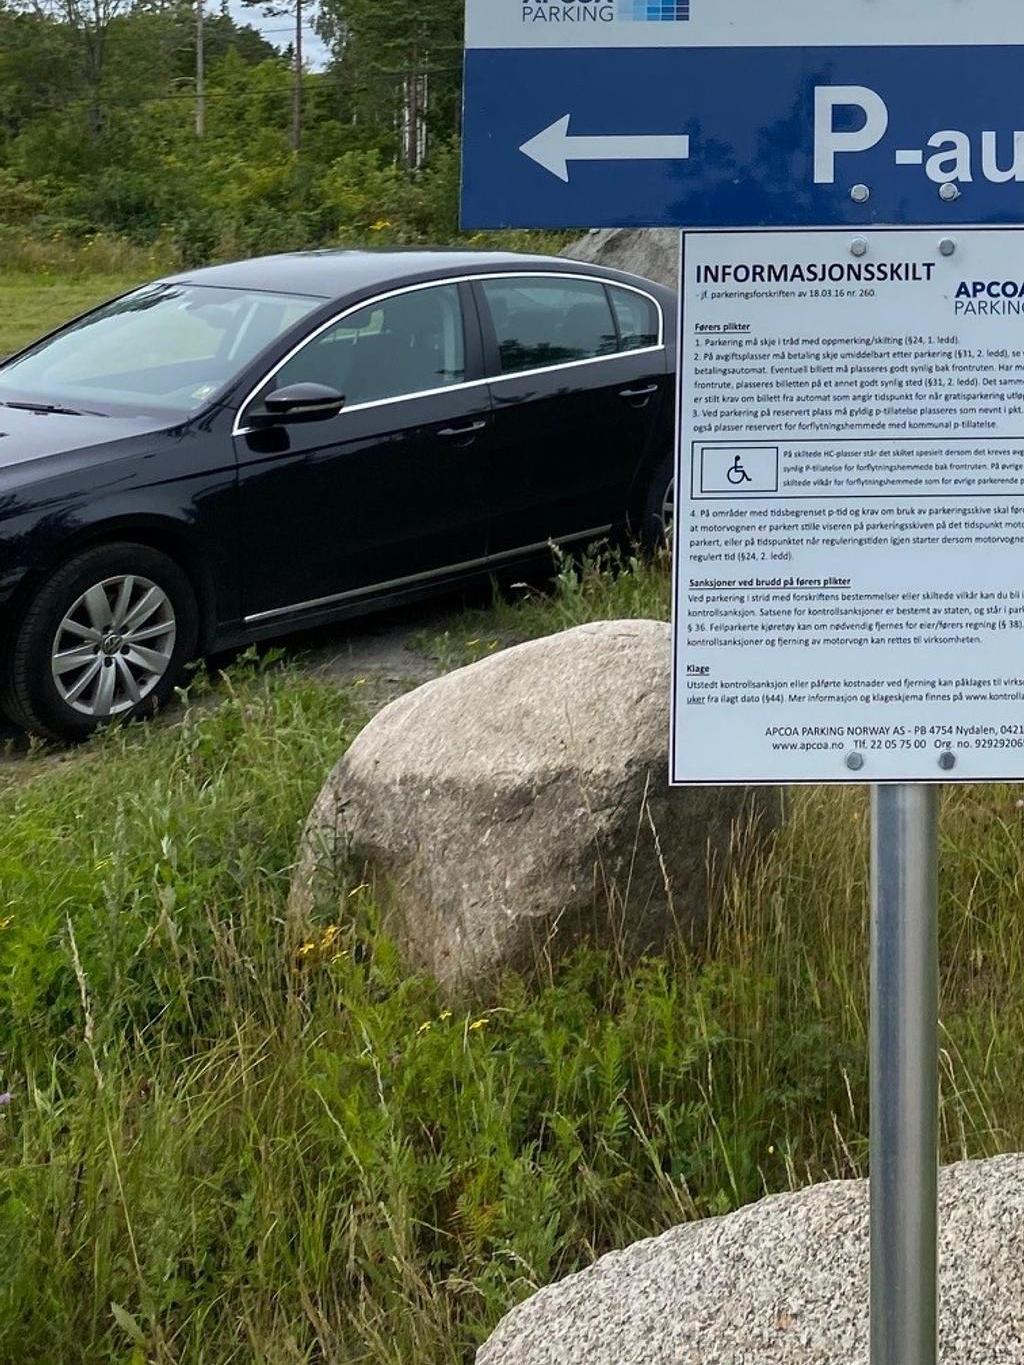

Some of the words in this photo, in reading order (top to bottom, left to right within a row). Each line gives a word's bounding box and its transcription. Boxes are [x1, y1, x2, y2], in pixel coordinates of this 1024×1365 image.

[522, 5, 614, 23] PARKING
[695, 262, 936, 284] INFORMASJONSSKILT
[710, 290, 796, 300] parkeringsforskriften
[694, 323, 721, 331] Førers
[722, 322, 750, 332] plikter
[770, 365, 808, 373] Eventuell
[809, 365, 833, 373] billett
[850, 365, 888, 374] plasseres
[889, 364, 908, 374] godt
[910, 364, 933, 374] synlig
[934, 364, 950, 372] bak
[998, 364, 1013, 372] Har
[692, 423, 712, 433] også
[713, 423, 743, 433] plasser
[744, 423, 783, 431] reservert
[784, 423, 796, 431] for
[797, 422, 886, 432] forflytningshemmede
[887, 421, 906, 430] med
[907, 421, 952, 429] kommunal
[700, 524, 756, 533] motorvognen
[768, 523, 799, 533] parkert
[800, 523, 820, 531] stille
[821, 523, 852, 531] viseren
[865, 522, 934, 532] parkeringsskiven
[948, 522, 962, 530] det
[964, 522, 1003, 531] tidspunkt
[723, 538, 742, 546] eller
[756, 537, 804, 547] tidspunktet
[805, 537, 820, 545] når
[821, 537, 888, 547] reguleringstiden
[889, 536, 910, 546] igjen
[911, 536, 939, 544] starter
[941, 536, 973, 544] dersom
[689, 553, 722, 563] regulert
[723, 552, 735, 561] tid
[689, 578, 736, 588] Sanksjoner
[738, 578, 754, 586] ved
[755, 578, 781, 586] brudd
[795, 578, 821, 586] førers
[822, 578, 851, 587] plikter
[759, 608, 792, 616] Satsene
[793, 608, 806, 616] for
[807, 607, 883, 617] kontrollsanksjoner
[895, 607, 930, 615] bestemt
[986, 606, 1002, 614] står
[686, 637, 763, 647] kontrollsanksjoner
[777, 636, 810, 646] fjerning
[822, 636, 869, 646] motorvogn
[870, 636, 886, 644] kan
[887, 636, 911, 644] rettes
[912, 636, 922, 644] til
[686, 664, 709, 674] Klage
[686, 681, 718, 689] Utstedt
[719, 680, 788, 690] kontrollsanksjon
[789, 680, 809, 688] eller
[810, 680, 841, 690] påførte
[842, 679, 884, 687] kostnader
[886, 679, 902, 687] ved
[903, 679, 936, 689] fjerning
[937, 679, 953, 687] kan
[954, 679, 991, 688] påklages
[992, 678, 1002, 686] til
[686, 694, 705, 704] uker
[706, 694, 719, 702] fra
[720, 694, 739, 704] ilagt
[740, 694, 760, 702] dato
[788, 694, 806, 702] Mer
[807, 694, 858, 704] informasjon
[872, 693, 923, 703] klageskjema
[925, 693, 951, 701] finnes
[765, 726, 799, 735] APCOA
[801, 726, 844, 735] PARKING
[846, 726, 890, 735] NORWAY
[892, 725, 906, 734] AS
[913, 725, 926, 734] PB
[928, 725, 953, 734] 4754
[955, 725, 998, 736] Nydalen,
[999, 725, 1024, 734] 0421
[771, 742, 844, 752] www.apcoa.no
[870, 740, 882, 749] 22
[884, 740, 897, 749] 05
[900, 740, 911, 749] 75
[913, 739, 926, 748] 00
